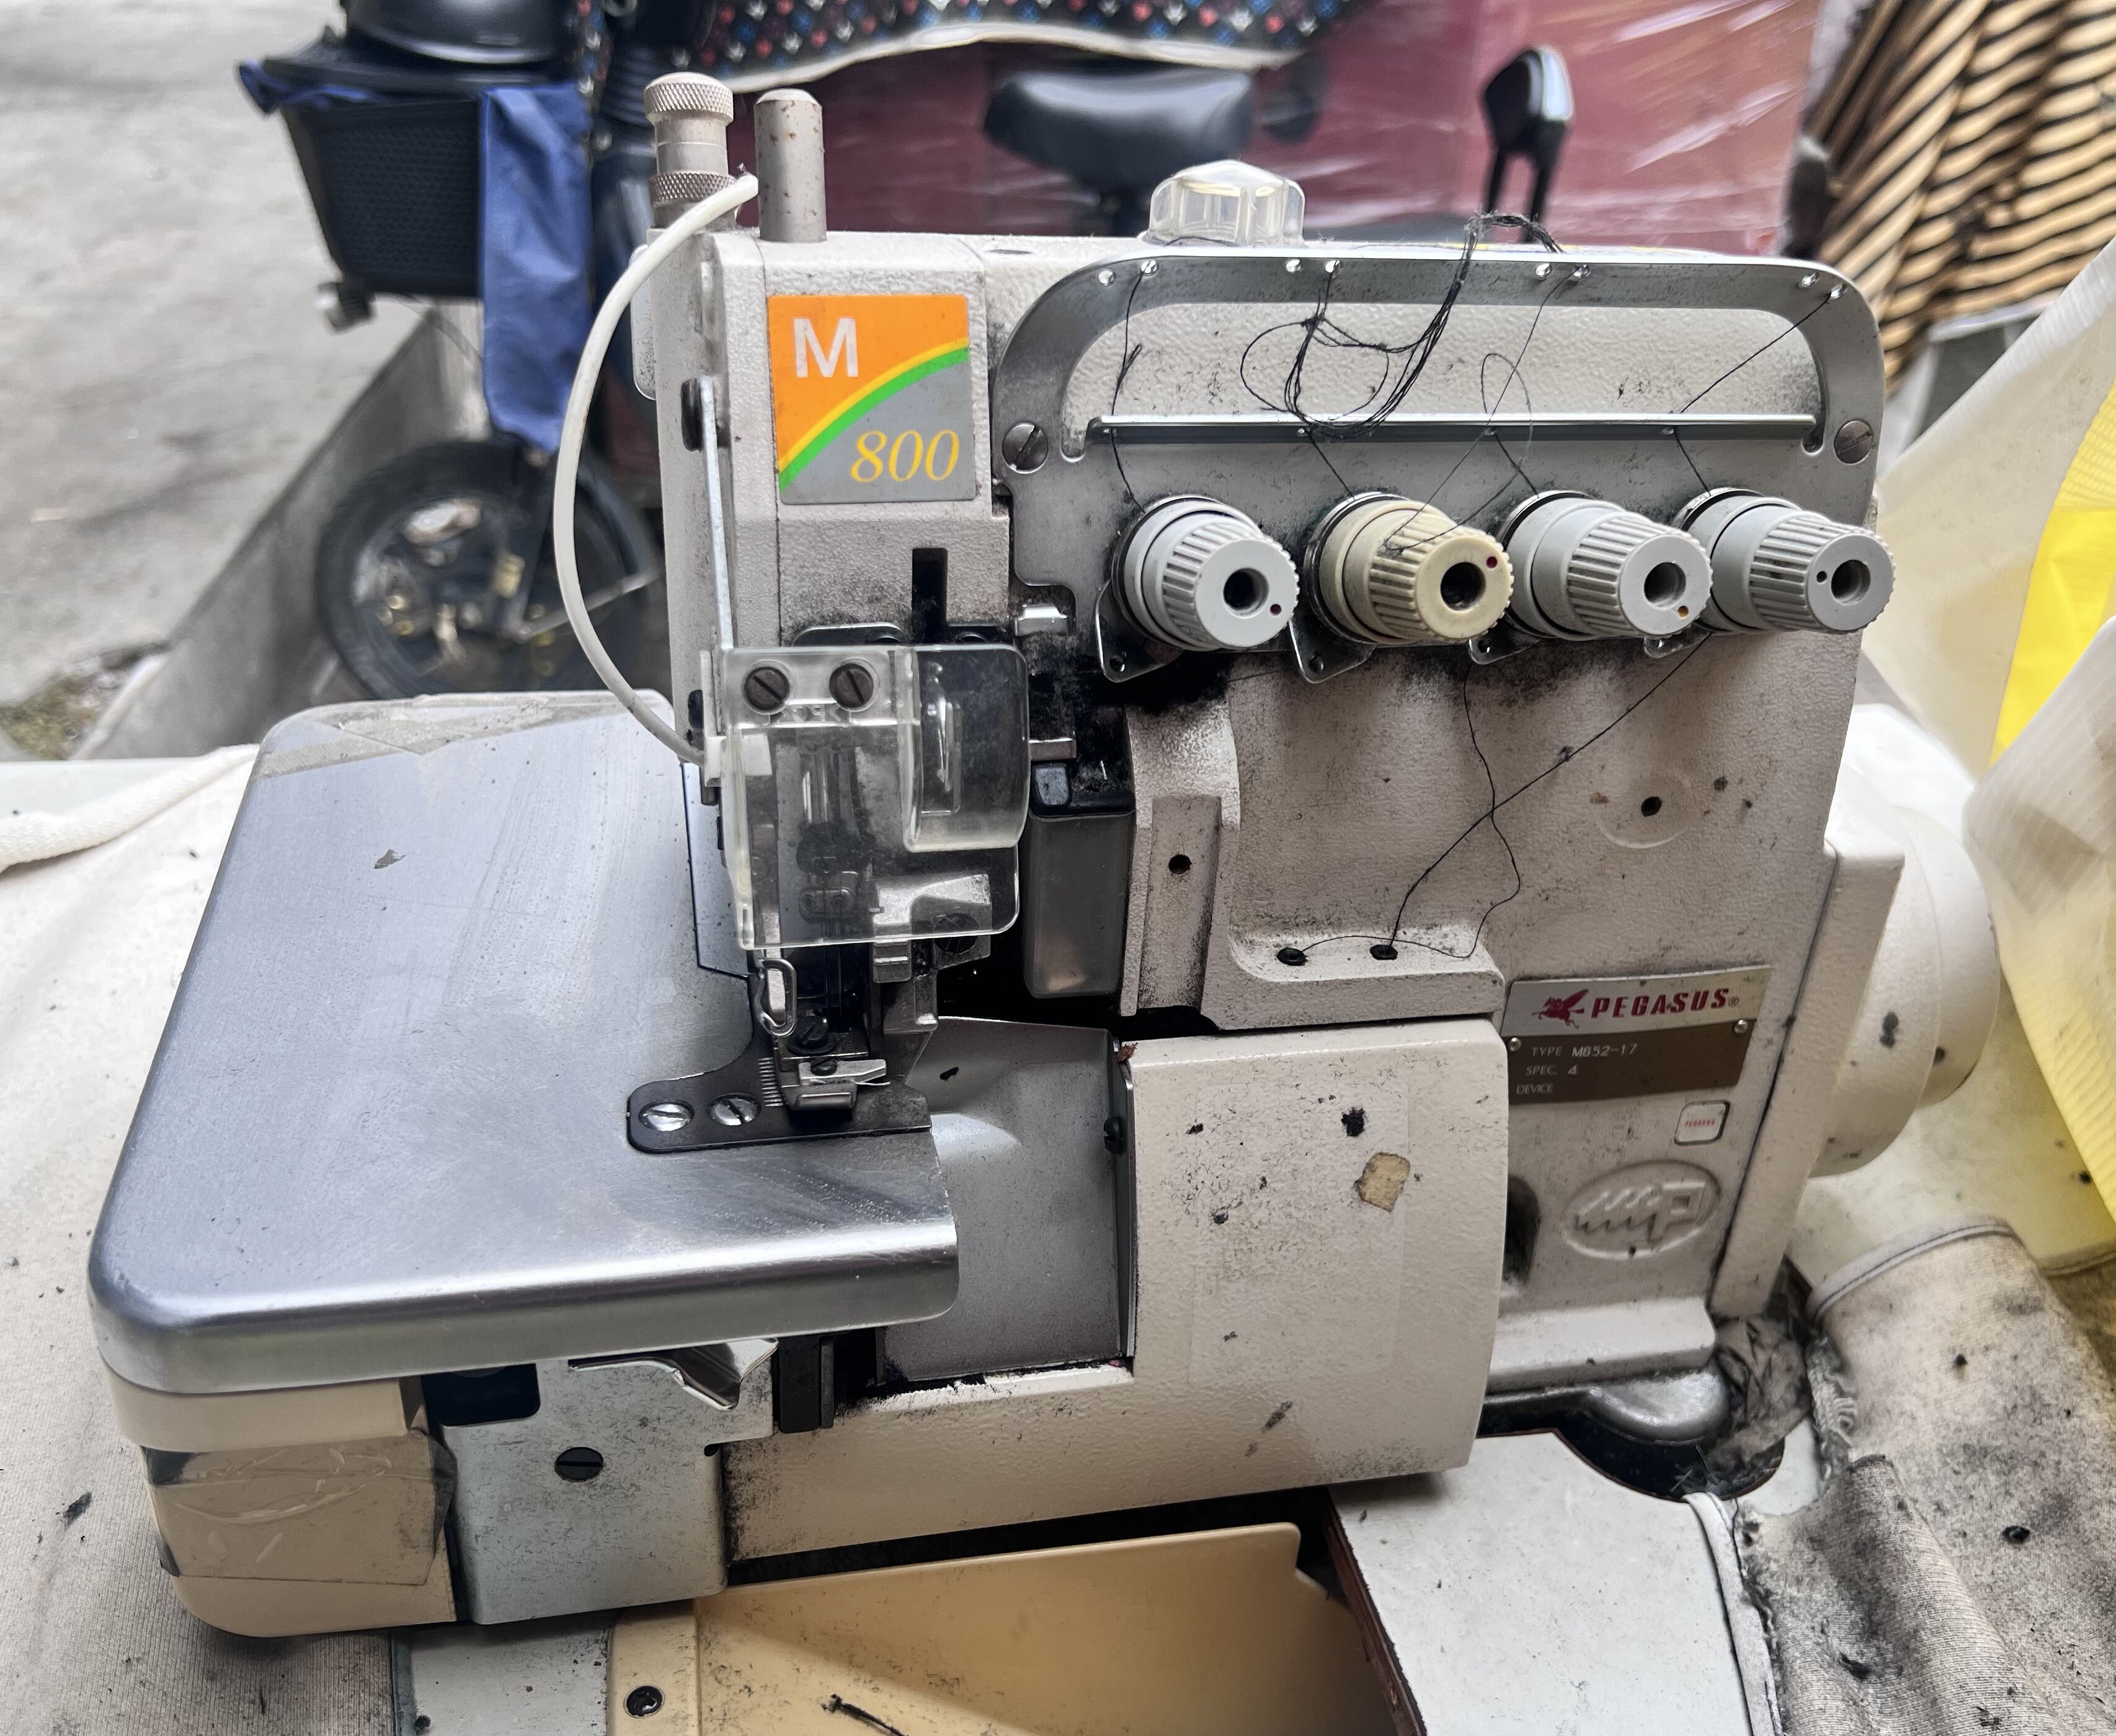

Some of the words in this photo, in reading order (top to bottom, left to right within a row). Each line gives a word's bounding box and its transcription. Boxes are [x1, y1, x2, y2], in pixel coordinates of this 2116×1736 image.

[793, 317, 858, 378] M
[850, 429, 959, 482] 800
[1532, 1046, 1562, 1057] TYPE
[1572, 1043, 1637, 1058] M852-17
[1567, 1064, 1577, 1075] 4
[1516, 1083, 1553, 1094] DEVICE
